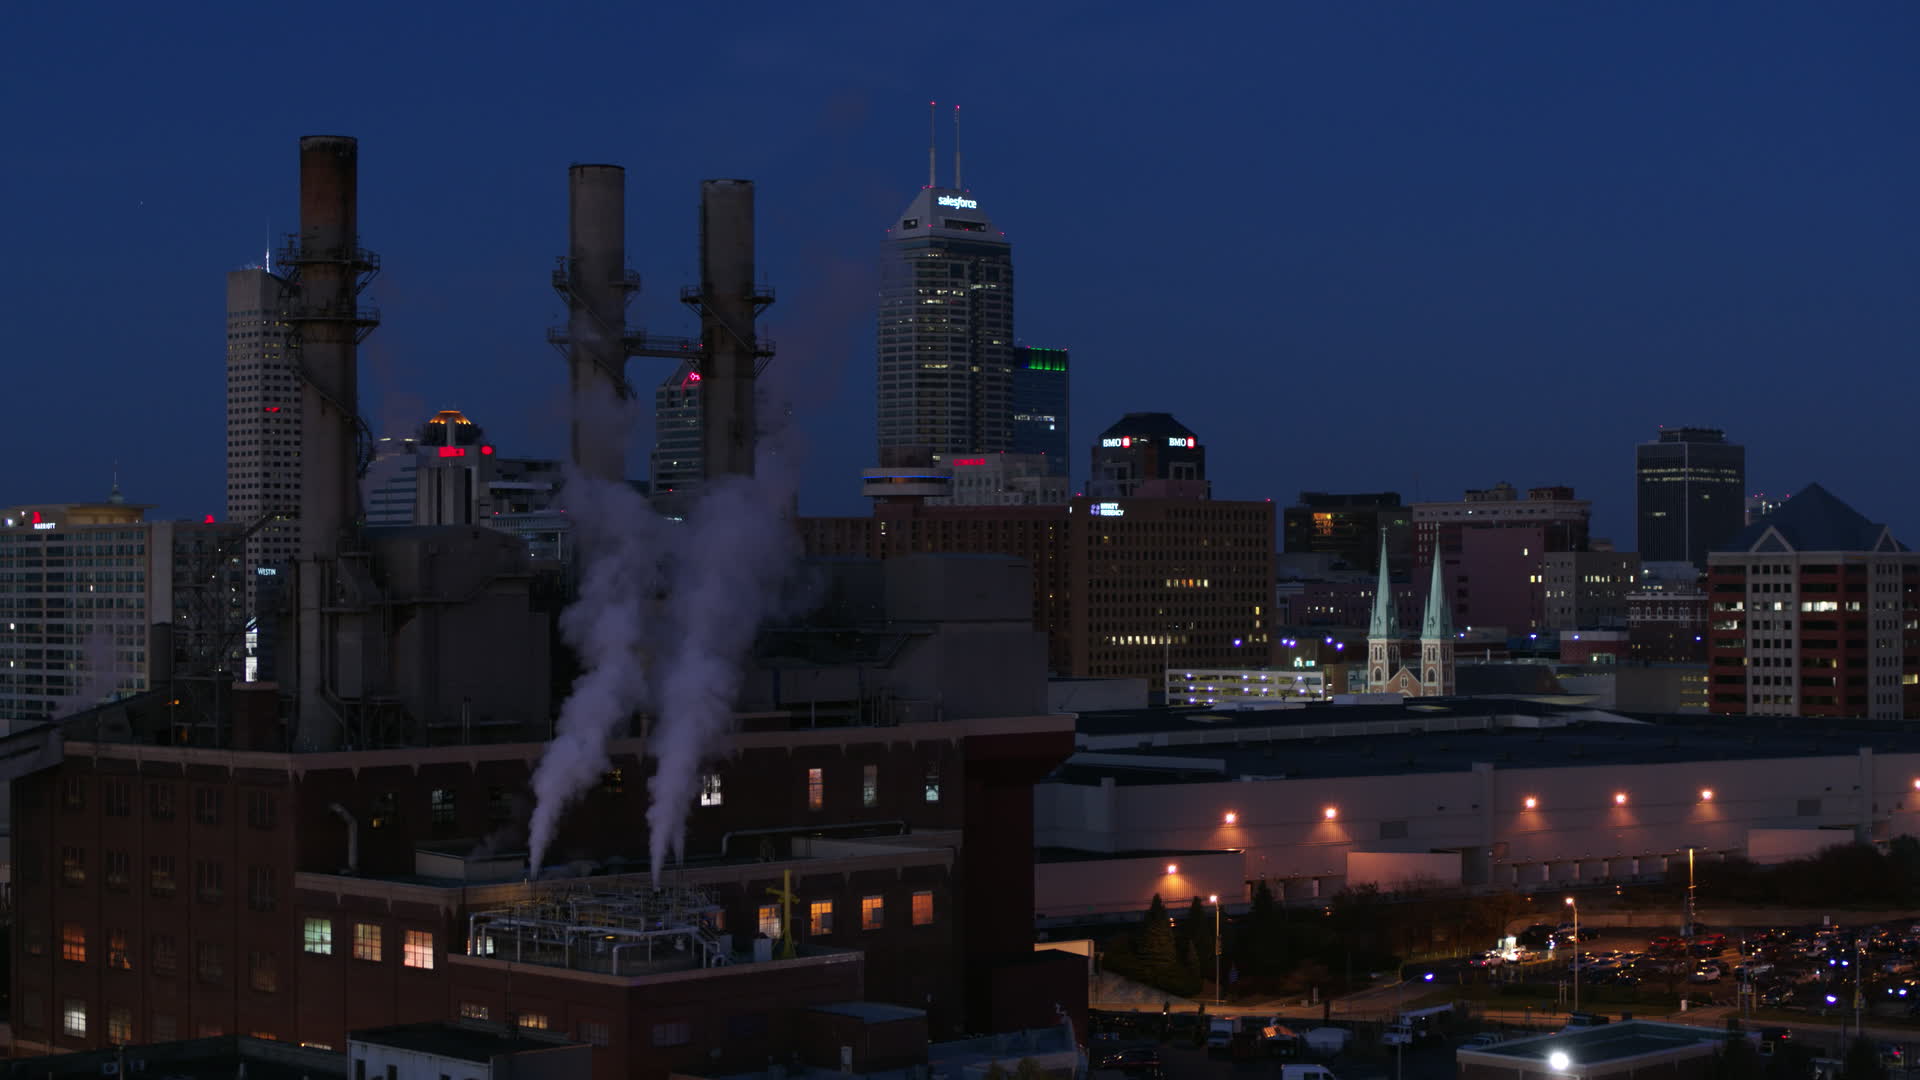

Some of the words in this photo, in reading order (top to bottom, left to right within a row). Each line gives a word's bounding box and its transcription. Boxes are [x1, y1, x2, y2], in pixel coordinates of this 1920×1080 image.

[938, 195, 977, 209] salesforce
[1103, 438, 1121, 447] BMO
[1169, 438, 1186, 447] BMO
[257, 568, 276, 576] WESTIN
